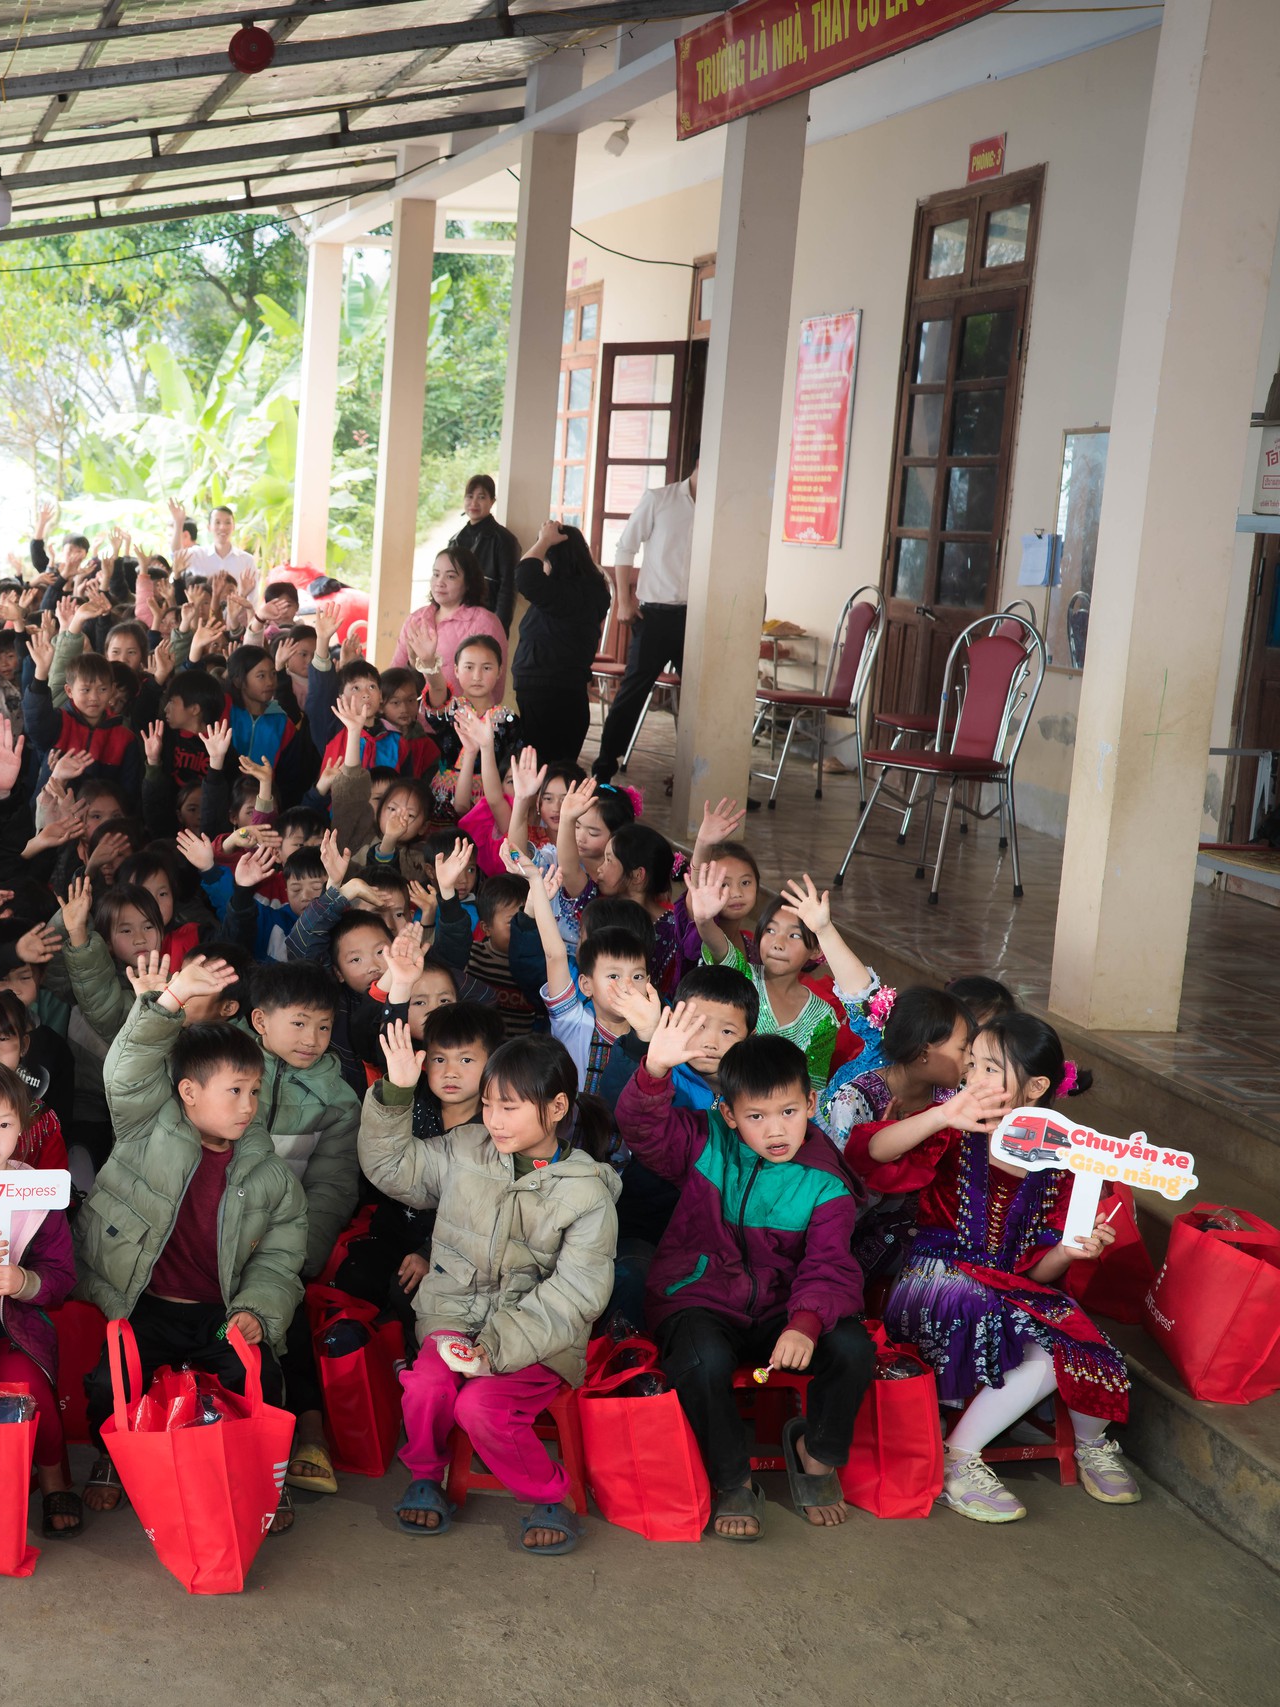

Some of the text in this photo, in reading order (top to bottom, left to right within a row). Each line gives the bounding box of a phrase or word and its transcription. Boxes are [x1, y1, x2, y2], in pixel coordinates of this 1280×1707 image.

[696, 37, 746, 104] TRƯỜNG
[749, 19, 768, 81] LÀ
[772, 1, 808, 72] NHÀ,
[1070, 1129, 1158, 1163] Chuyến
[1162, 1151, 1190, 1169] xe
